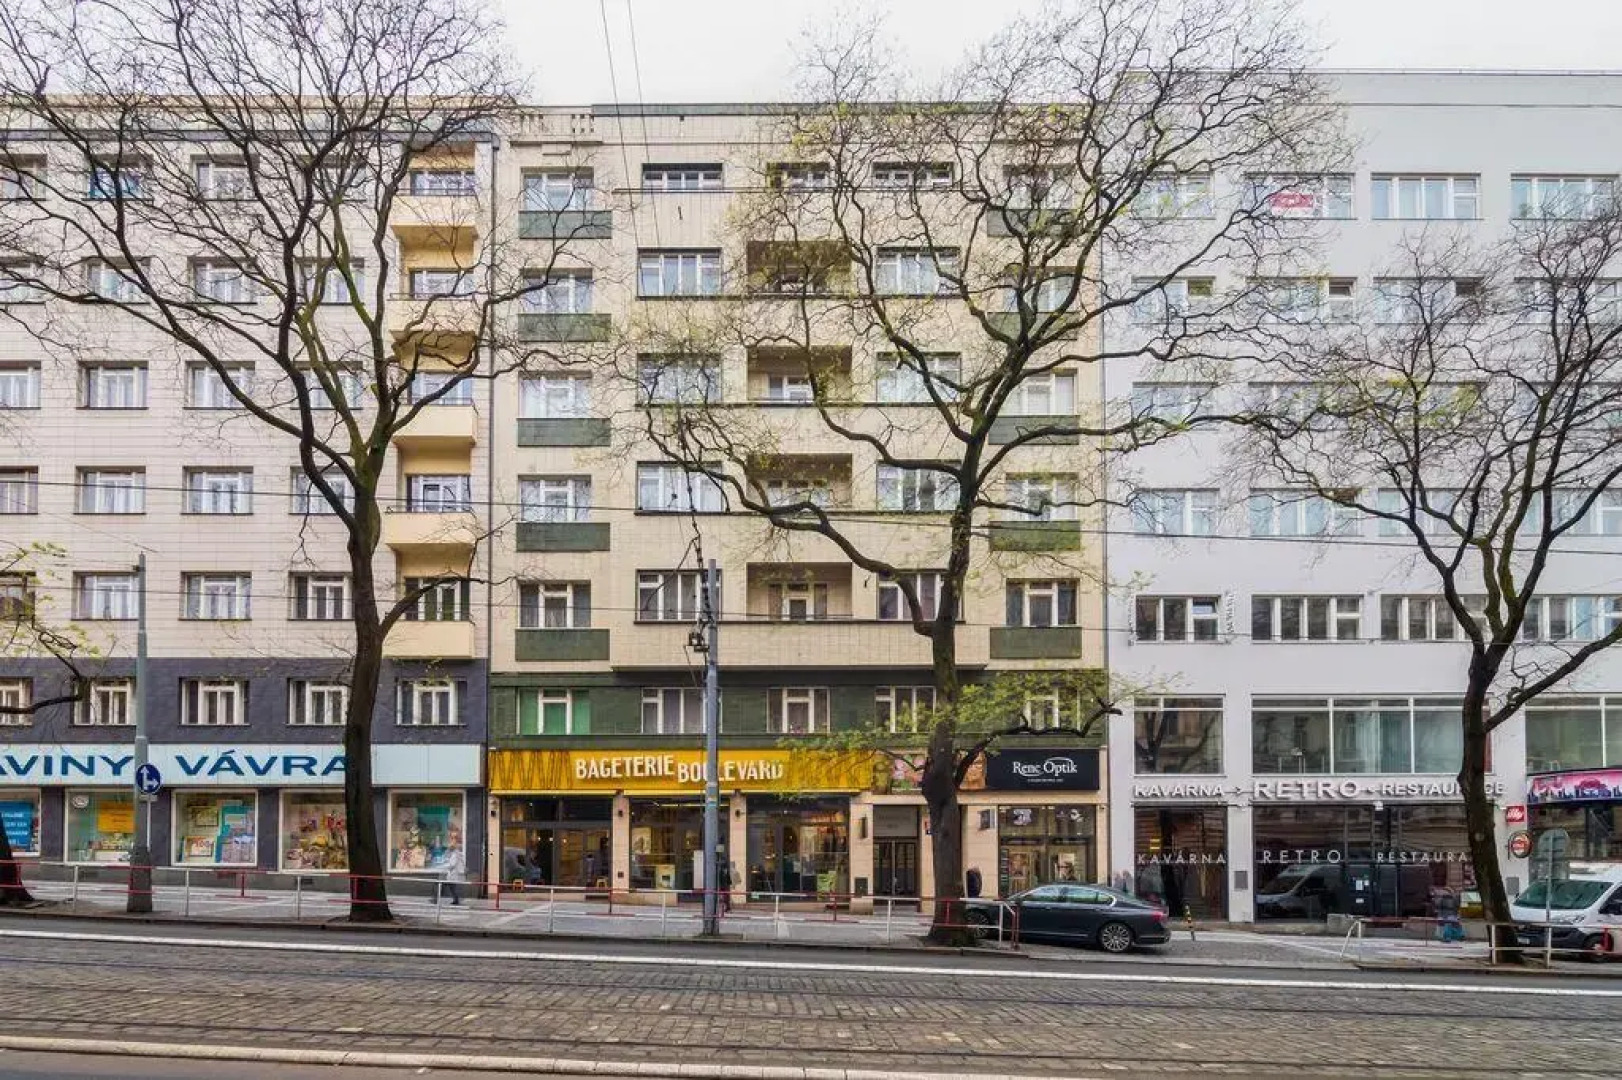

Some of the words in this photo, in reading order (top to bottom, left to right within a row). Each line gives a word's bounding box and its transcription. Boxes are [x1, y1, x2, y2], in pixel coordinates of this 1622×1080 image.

[0, 755, 133, 776] VINY
[175, 750, 346, 776] VÁVRA
[575, 755, 675, 779] BAGETERIE
[677, 760, 784, 783] BOEVARD
[1043, 756, 1078, 776] Optik
[1254, 780, 1360, 798] RETRO
[1382, 783, 1505, 797] RESTAUCE
[1137, 851, 1226, 864] KAVÁRNA
[1262, 850, 1341, 864] RETRO
[1377, 851, 1471, 863] RESTAURA
